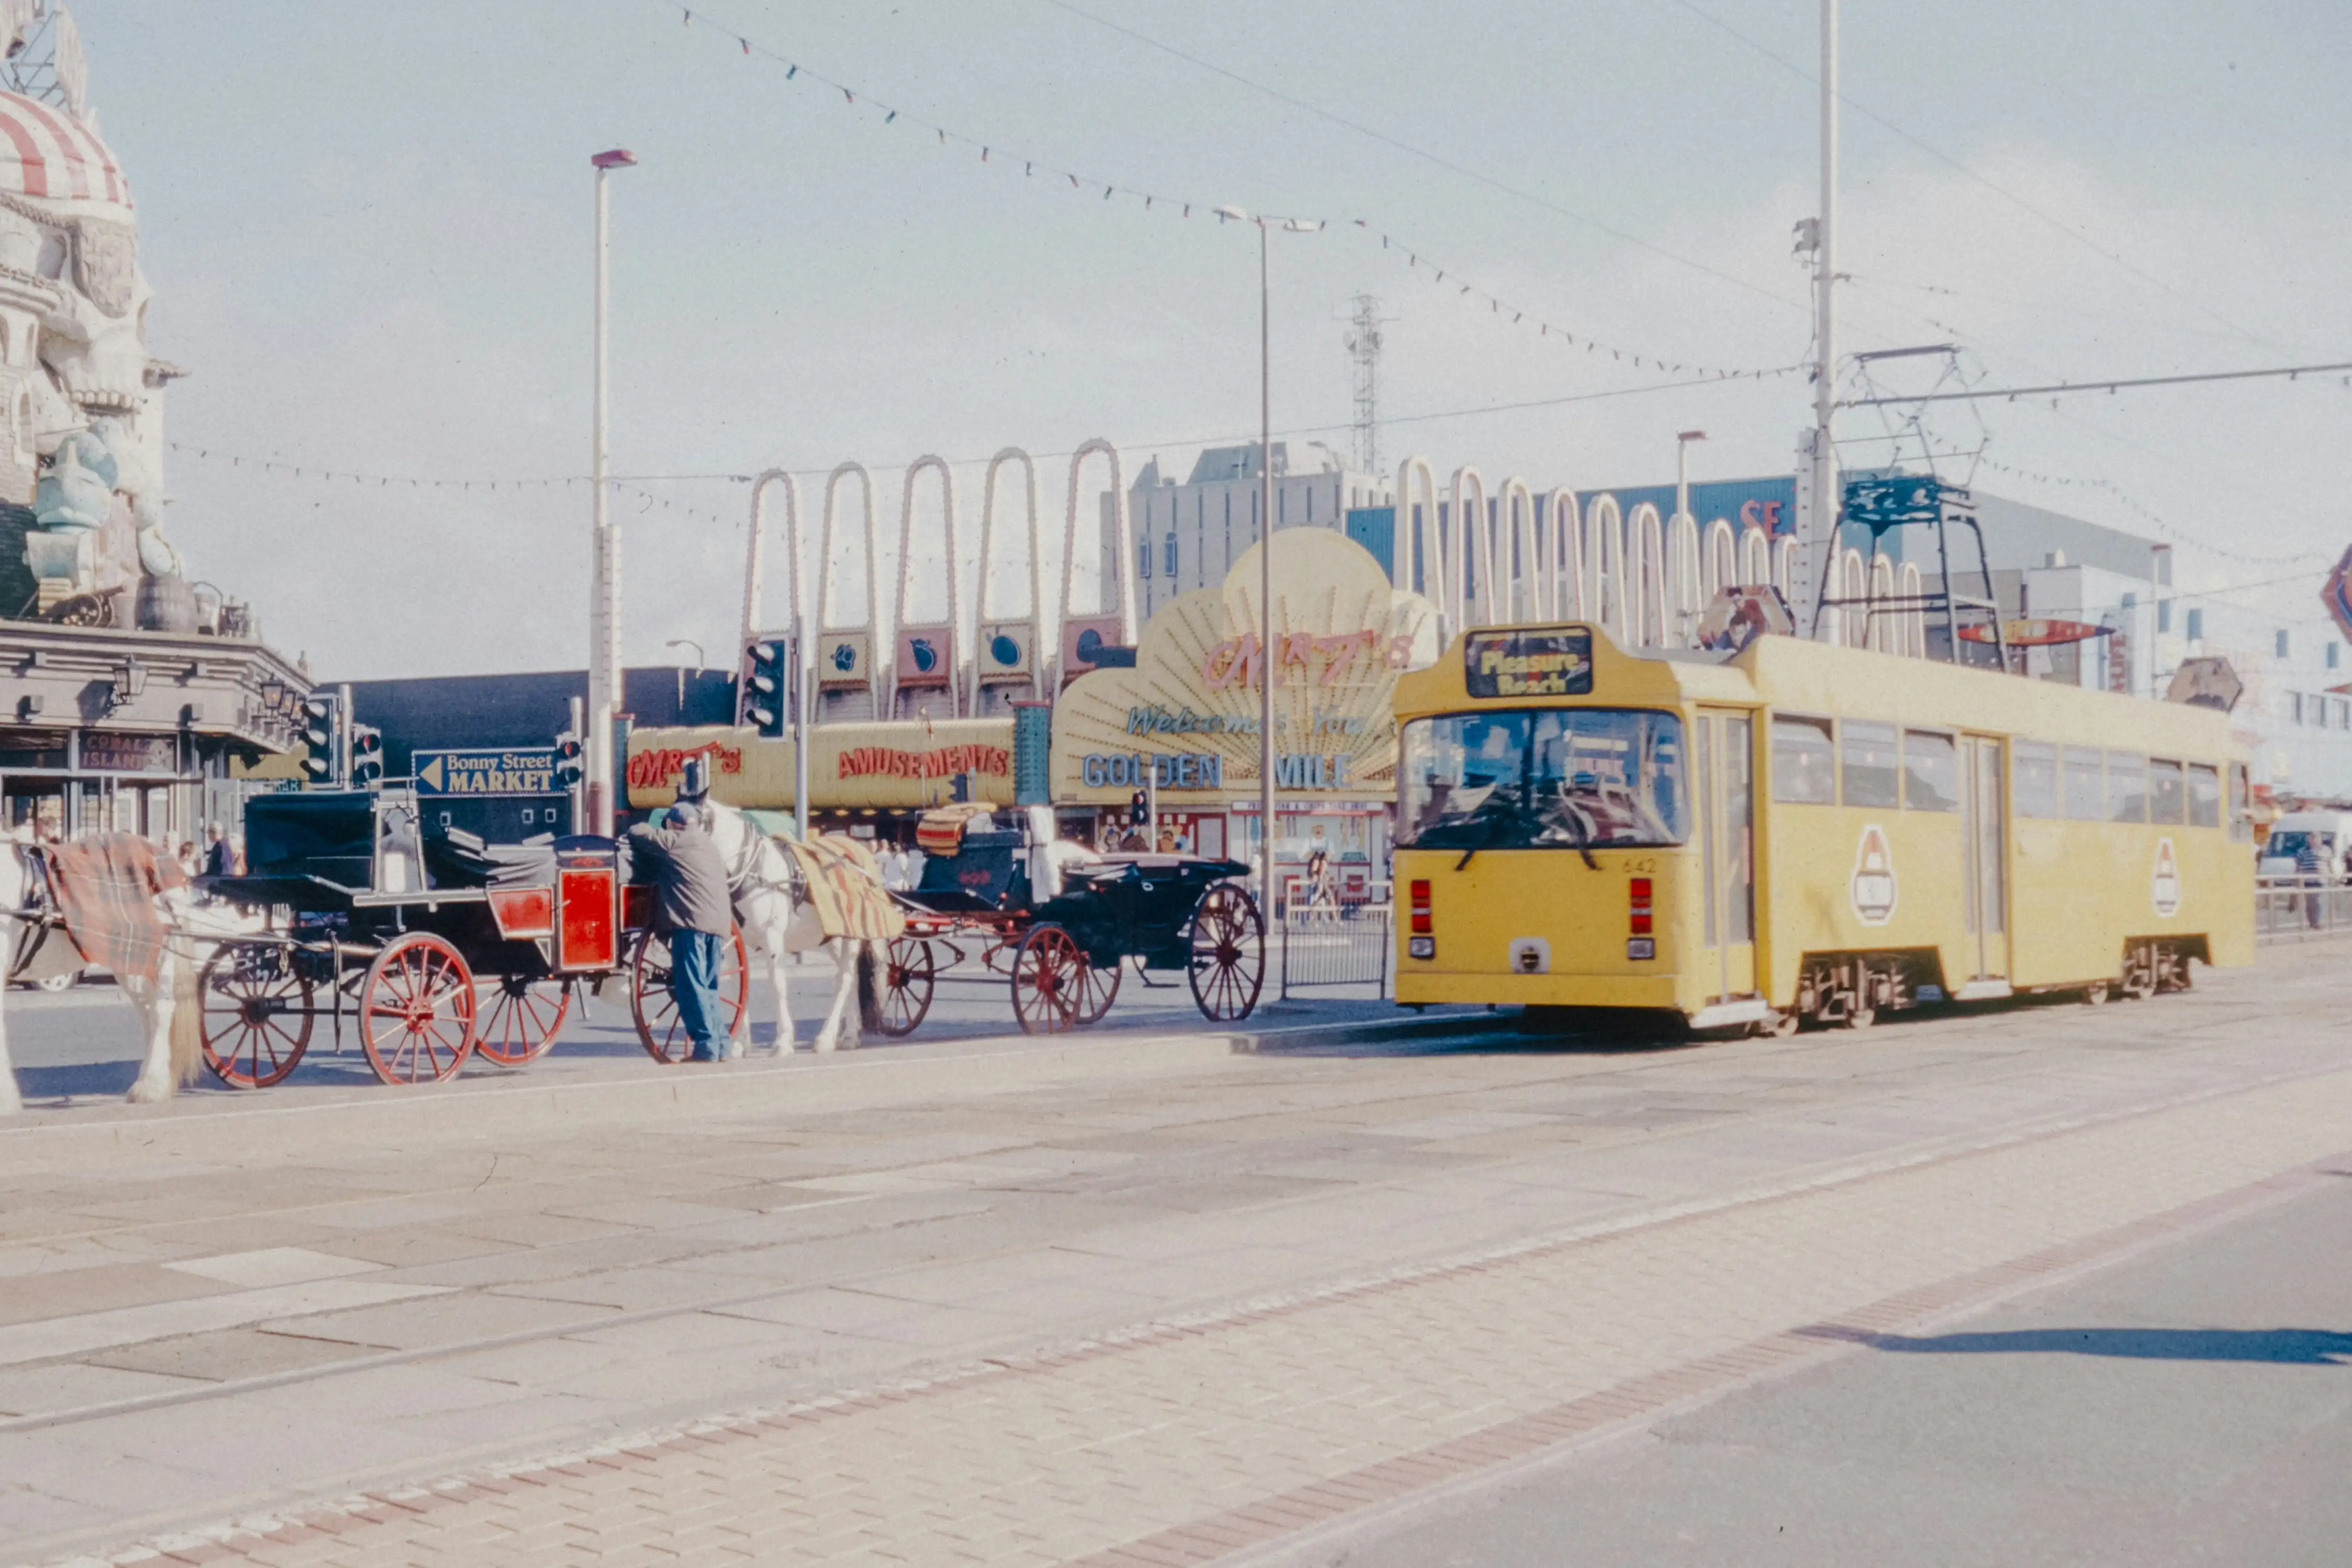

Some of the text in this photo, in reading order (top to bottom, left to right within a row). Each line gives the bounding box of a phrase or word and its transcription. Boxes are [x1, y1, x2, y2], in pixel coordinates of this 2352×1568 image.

[1481, 650, 1579, 674] Pleasure
[1498, 673, 1567, 695] Beach
[1126, 705, 1362, 735] Welcoms You
[87, 735, 142, 751] CORAL
[83, 751, 144, 771] ISLAND
[447, 754, 553, 771] Bonny Street
[839, 744, 1009, 779] AMUSEMENTS
[1082, 753, 1354, 788] GOLDEN MILE
[448, 770, 554, 792] MARKET
[1623, 857, 1657, 873] 642
